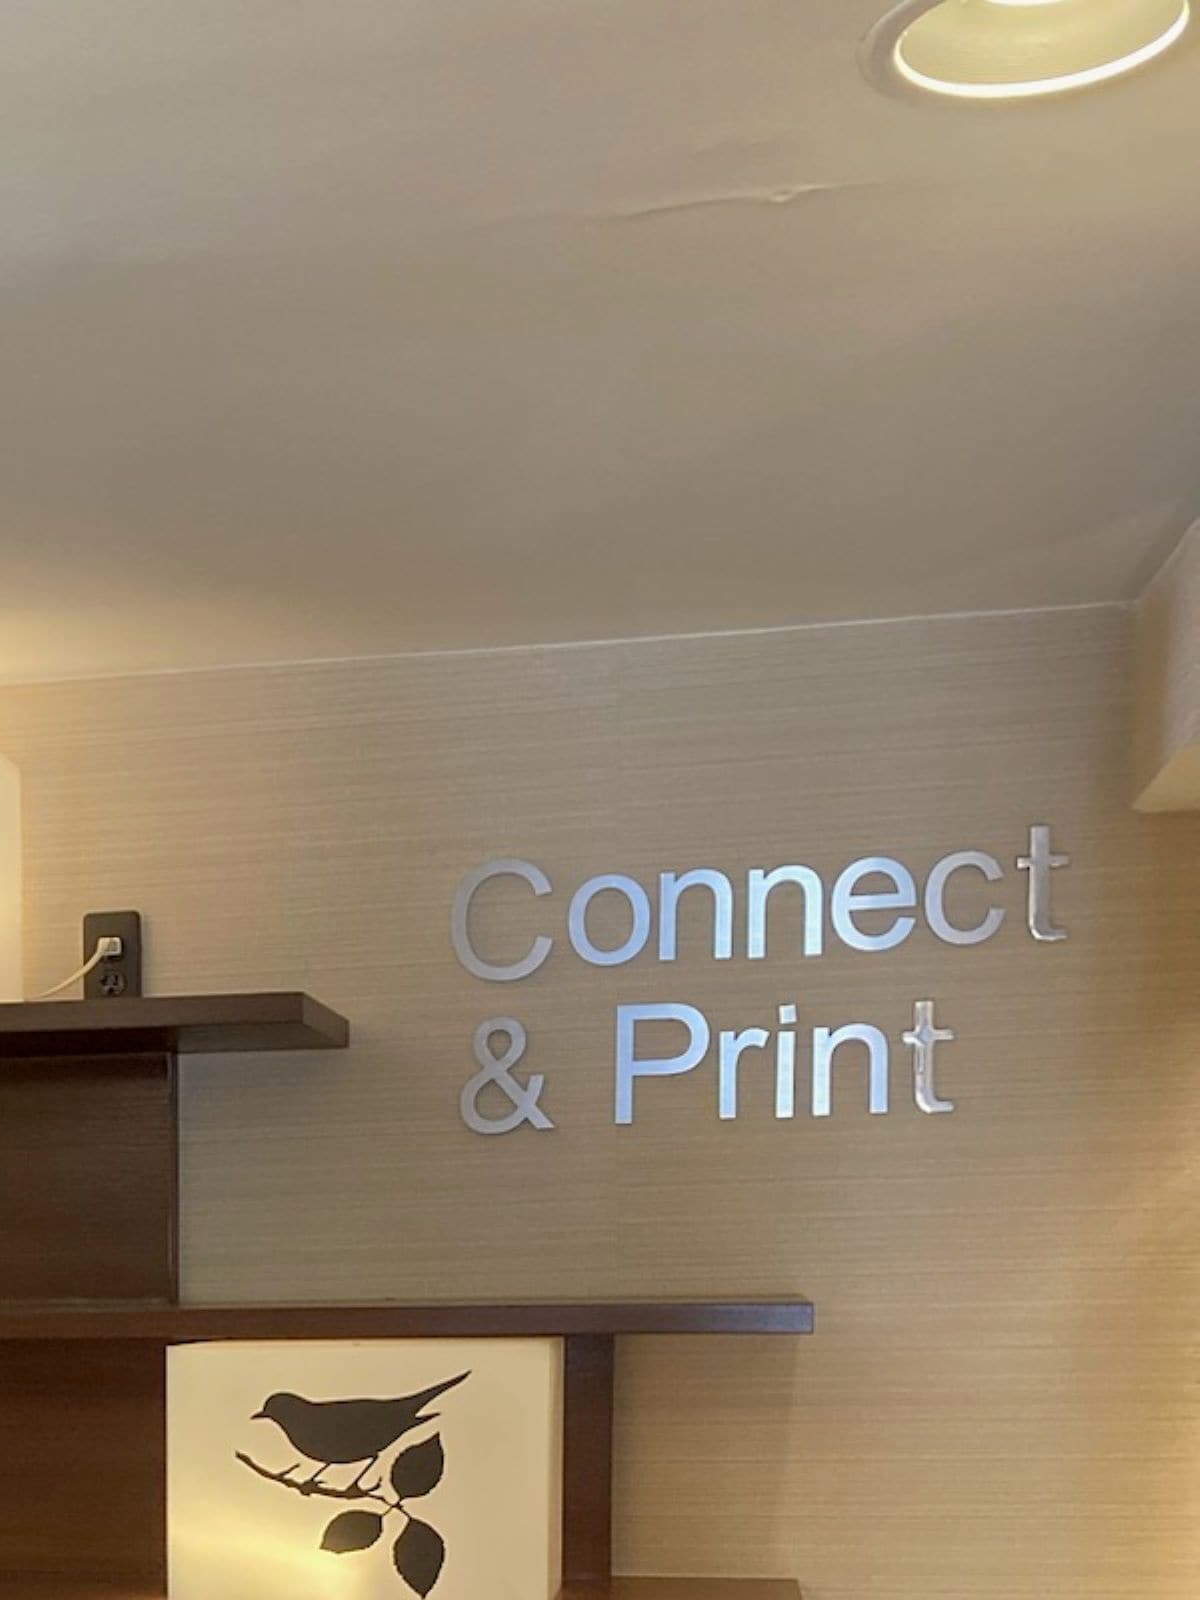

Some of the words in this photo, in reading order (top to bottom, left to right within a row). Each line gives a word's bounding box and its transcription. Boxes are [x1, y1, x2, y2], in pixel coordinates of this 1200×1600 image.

[451, 823, 1070, 981] Connect
[459, 1016, 555, 1135] &
[614, 1001, 955, 1125] Print
